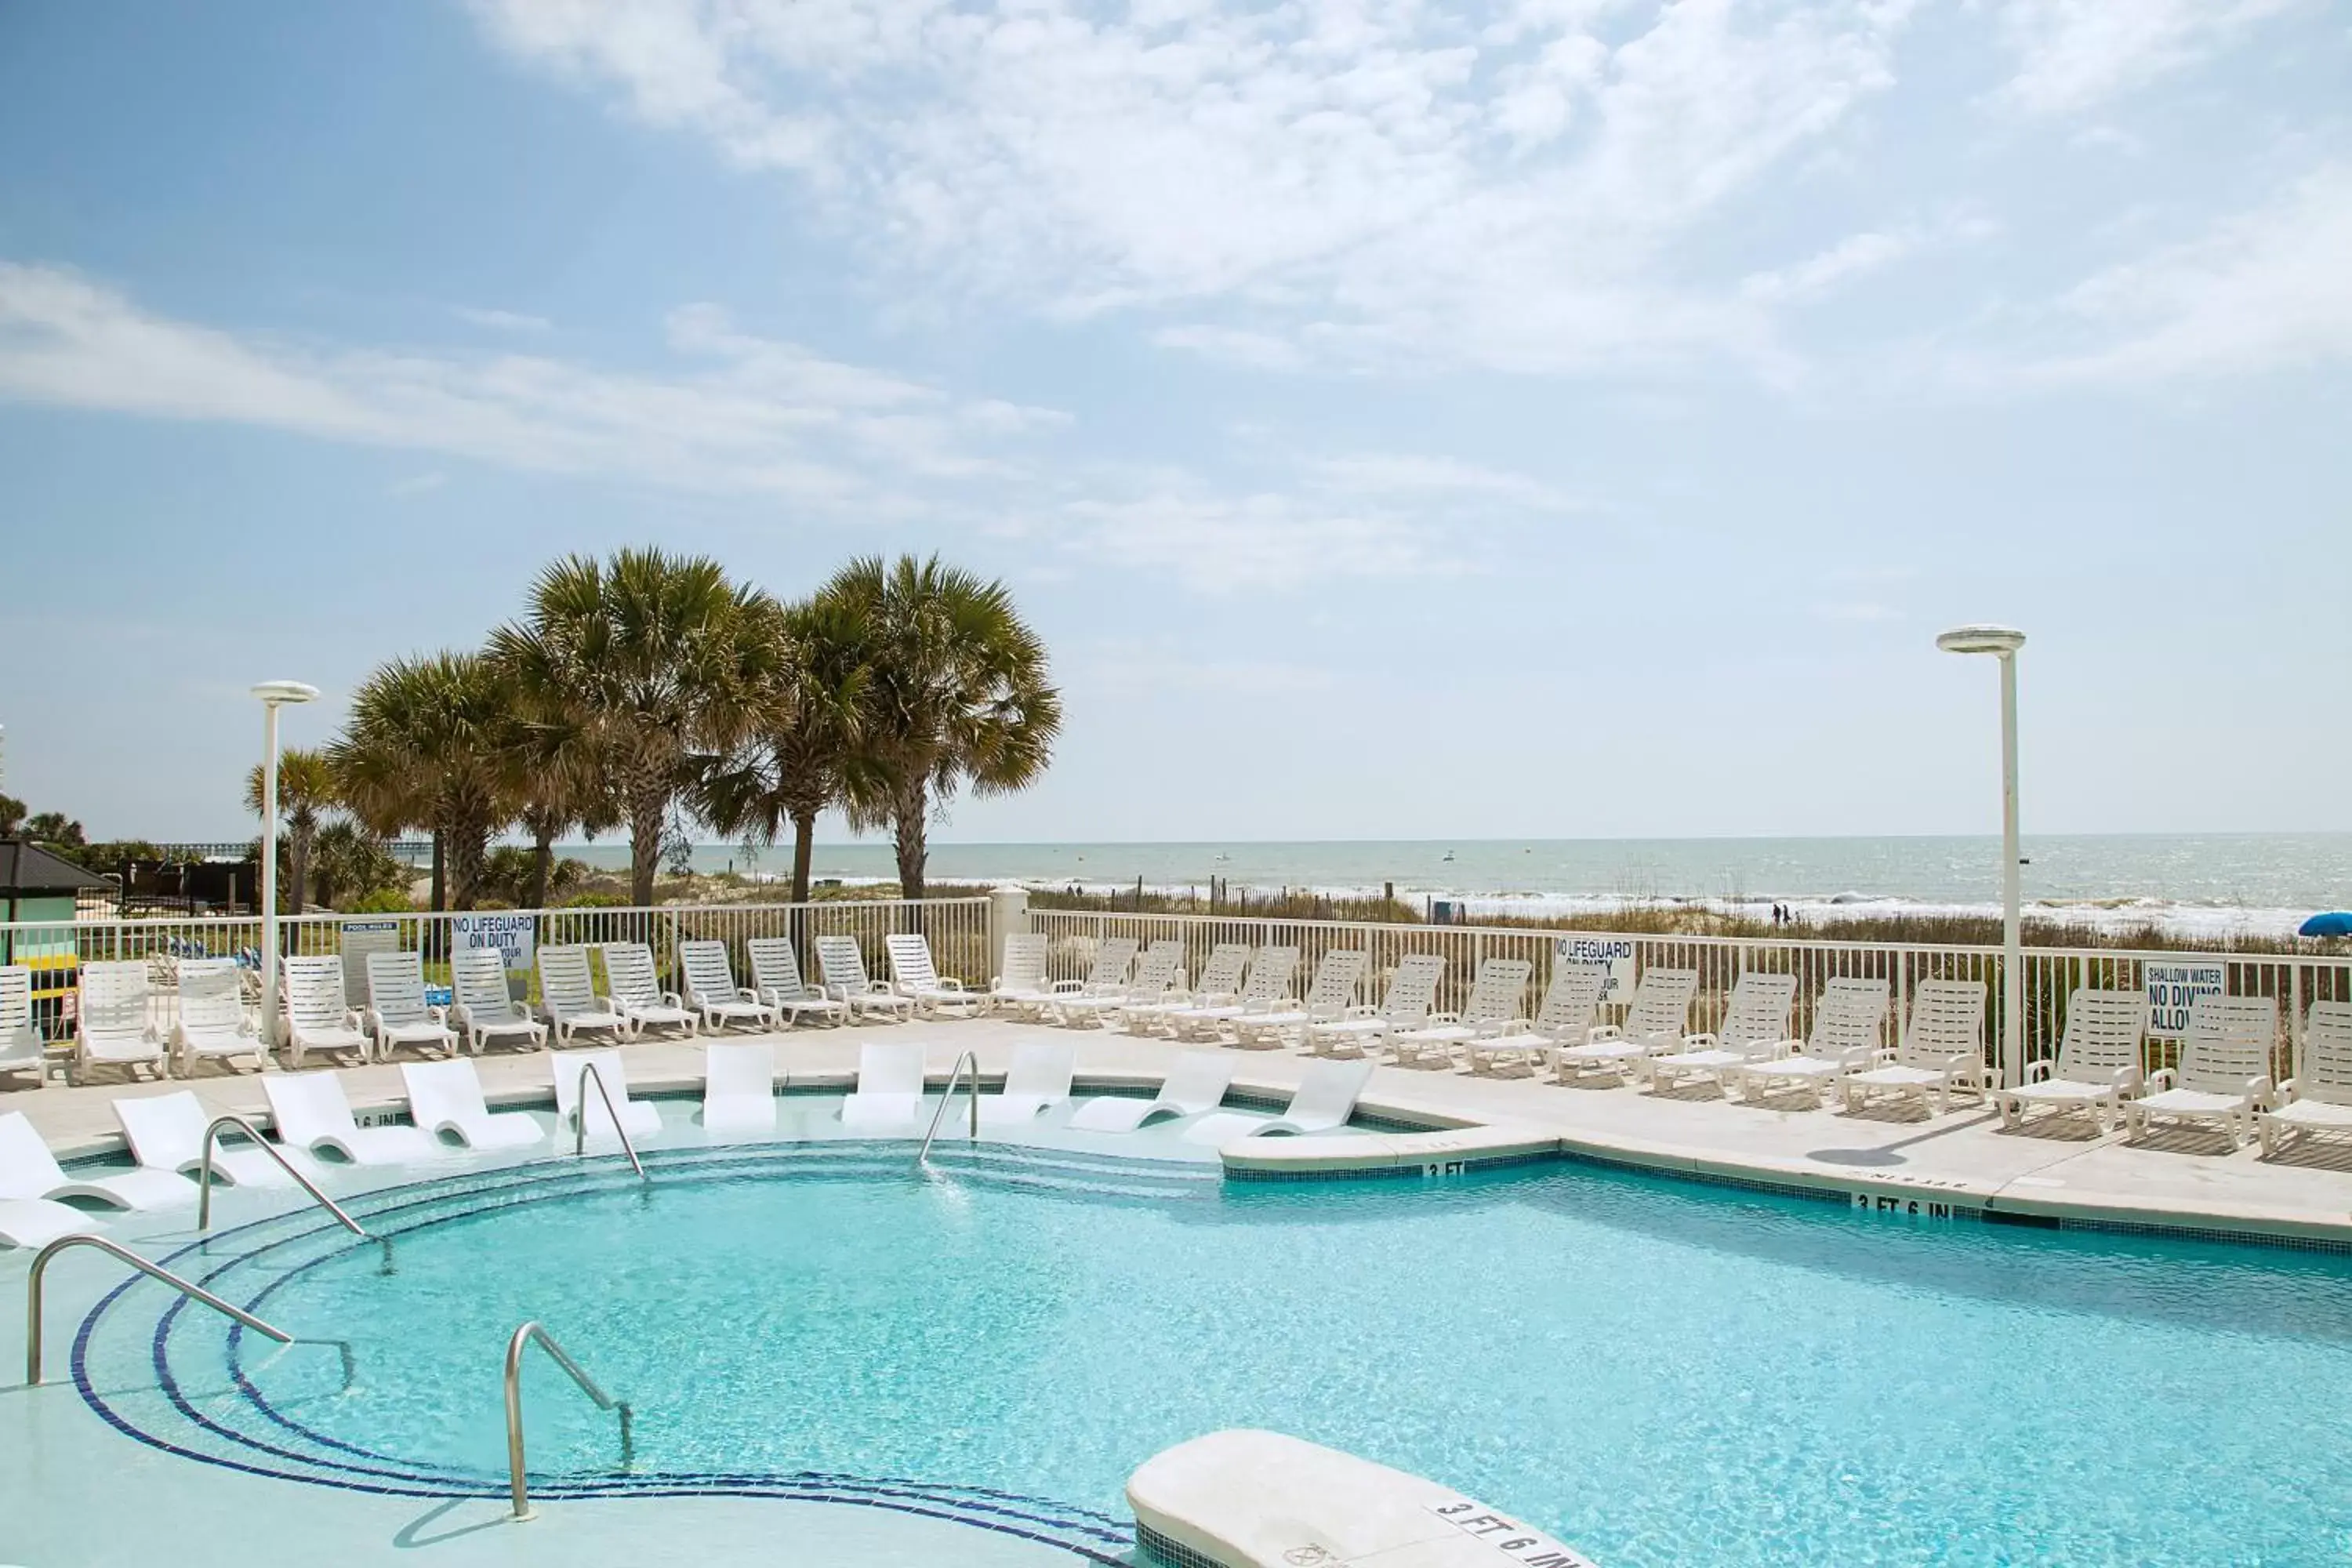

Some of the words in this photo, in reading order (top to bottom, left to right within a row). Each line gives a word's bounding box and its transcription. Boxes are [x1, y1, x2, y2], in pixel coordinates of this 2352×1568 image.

[452, 917, 470, 932] NO
[472, 916, 532, 932] LIFEGUARD
[470, 933, 485, 948] ON
[488, 932, 517, 948] DUTY
[1569, 940, 1632, 959] LIFEGUARD
[2148, 967, 2188, 983] SHALLOW
[2190, 968, 2221, 985] WATER
[2149, 984, 2168, 1006] NO
[378, 1114, 393, 1126] IN
[1445, 1161, 1462, 1175] FT
[1858, 1193, 1868, 1210] 3
[1877, 1195, 1900, 1212] FT
[1907, 1200, 1918, 1215] 6
[1928, 1202, 1949, 1218] IN
[1436, 1503, 1474, 1515] 3
[1459, 1515, 1515, 1534] FT
[1499, 1537, 1538, 1551] 6
[1523, 1552, 1582, 1568] IN
